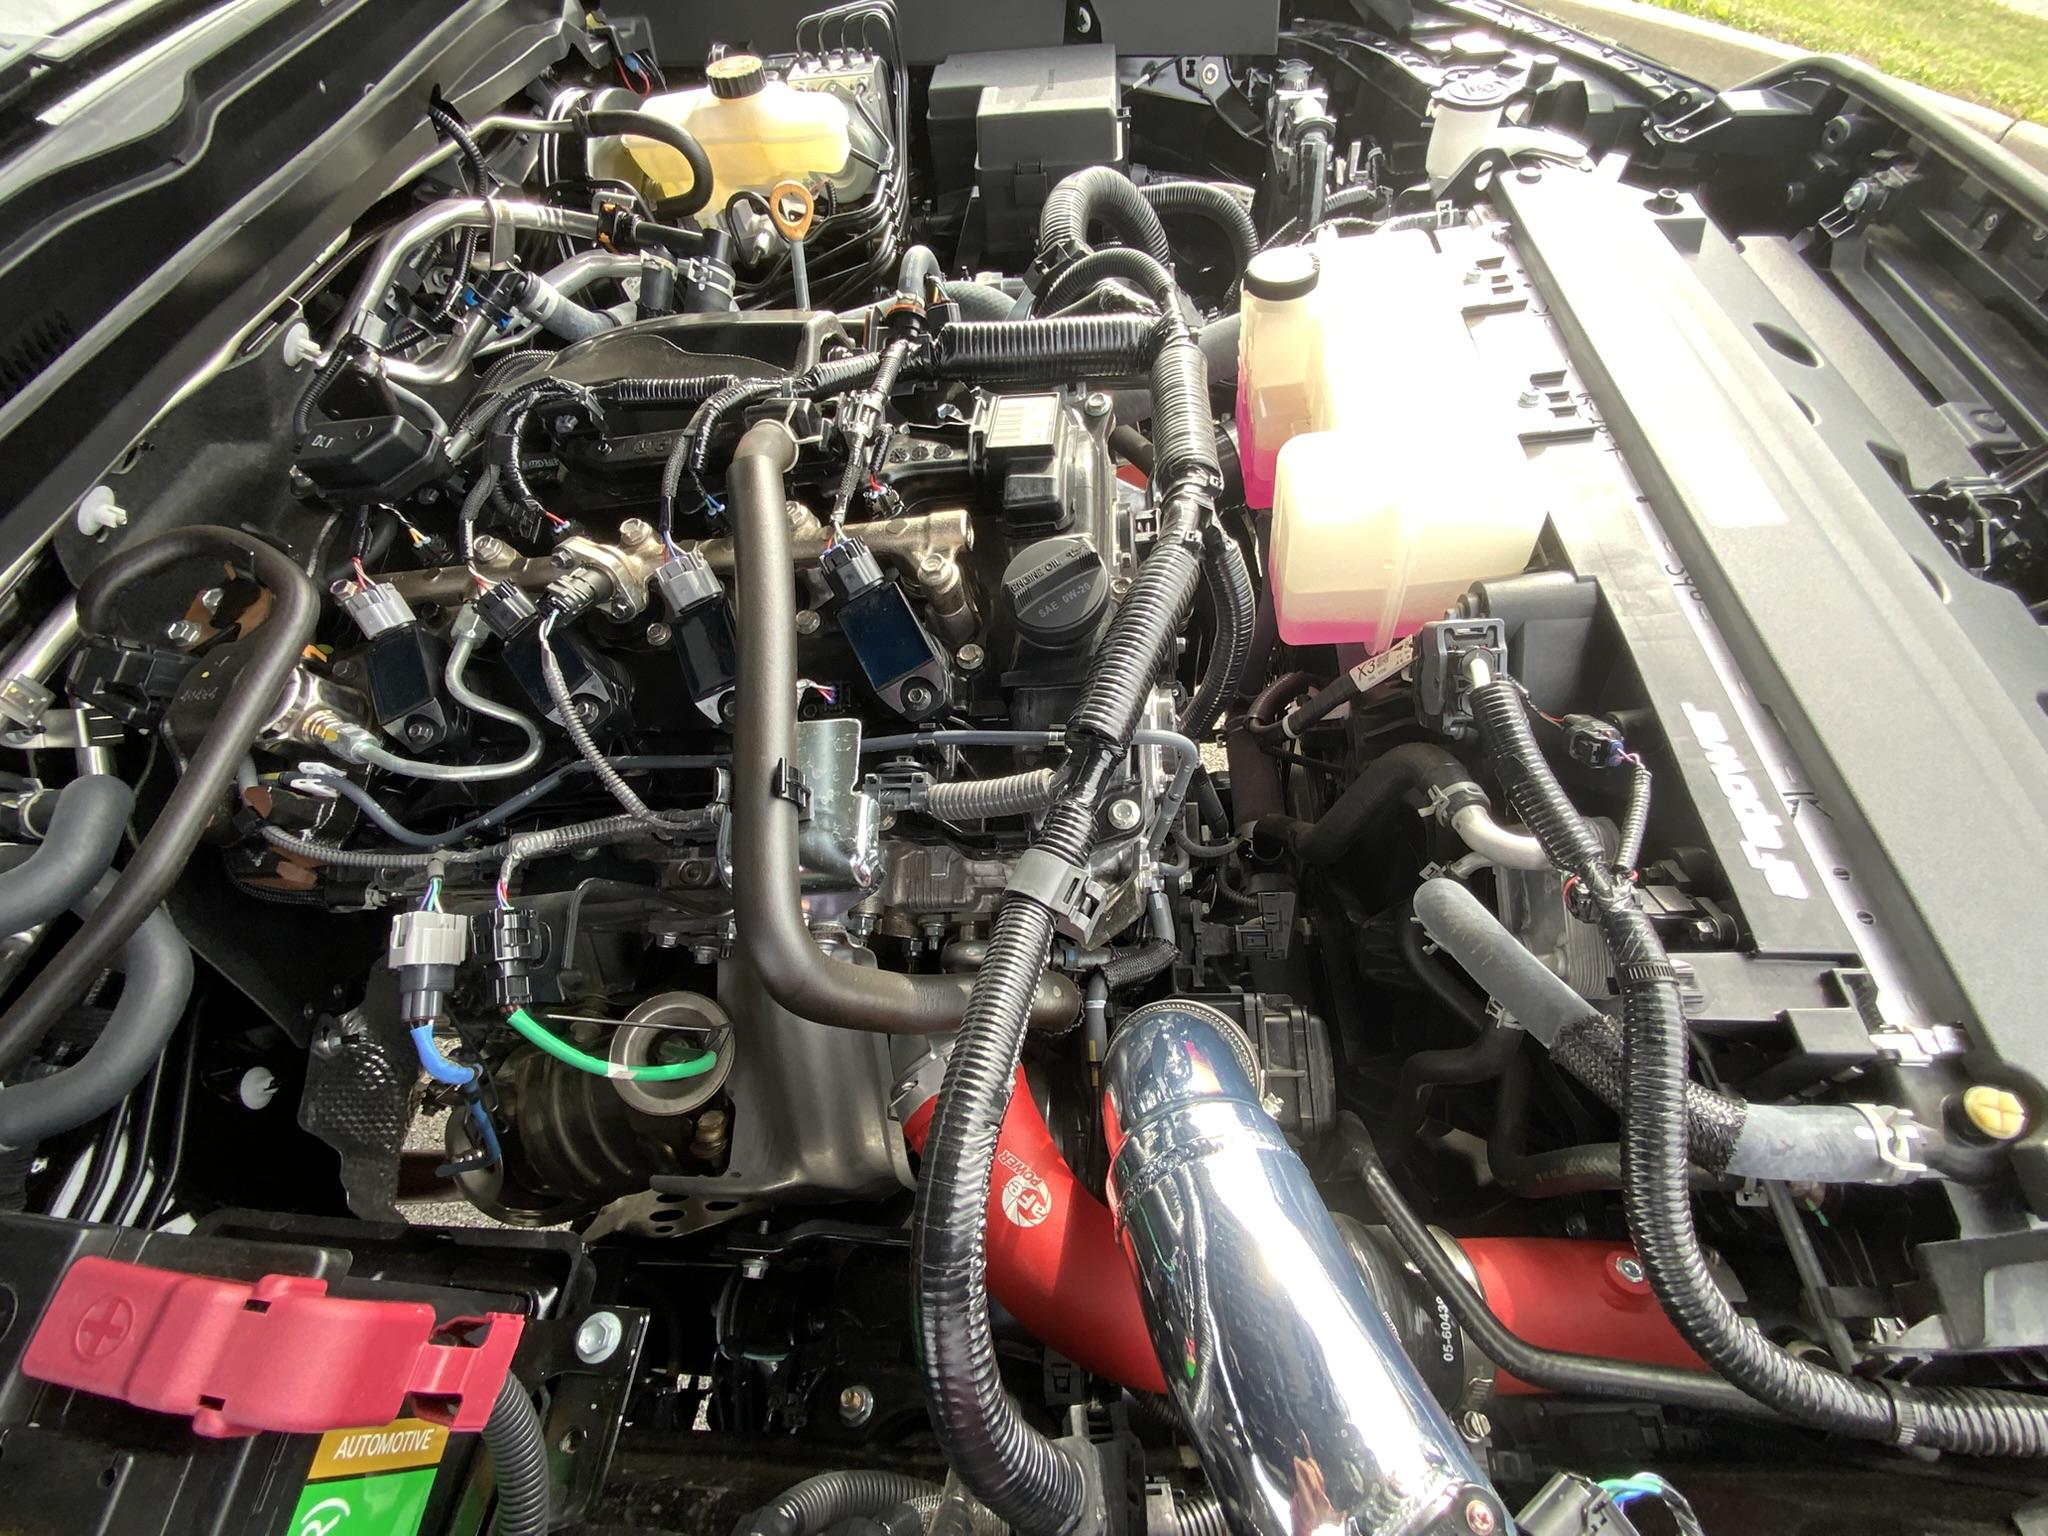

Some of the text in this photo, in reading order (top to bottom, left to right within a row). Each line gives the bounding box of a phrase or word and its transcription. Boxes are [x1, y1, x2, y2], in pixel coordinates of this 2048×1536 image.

[1010, 558, 1062, 593] ENGINE OIL
[1038, 582, 1092, 618] SAE 0W-20
[998, 1150, 1043, 1188] POWER
[1007, 1180, 1048, 1218] aFe
[333, 1428, 435, 1460] AUTOMOTIVE
